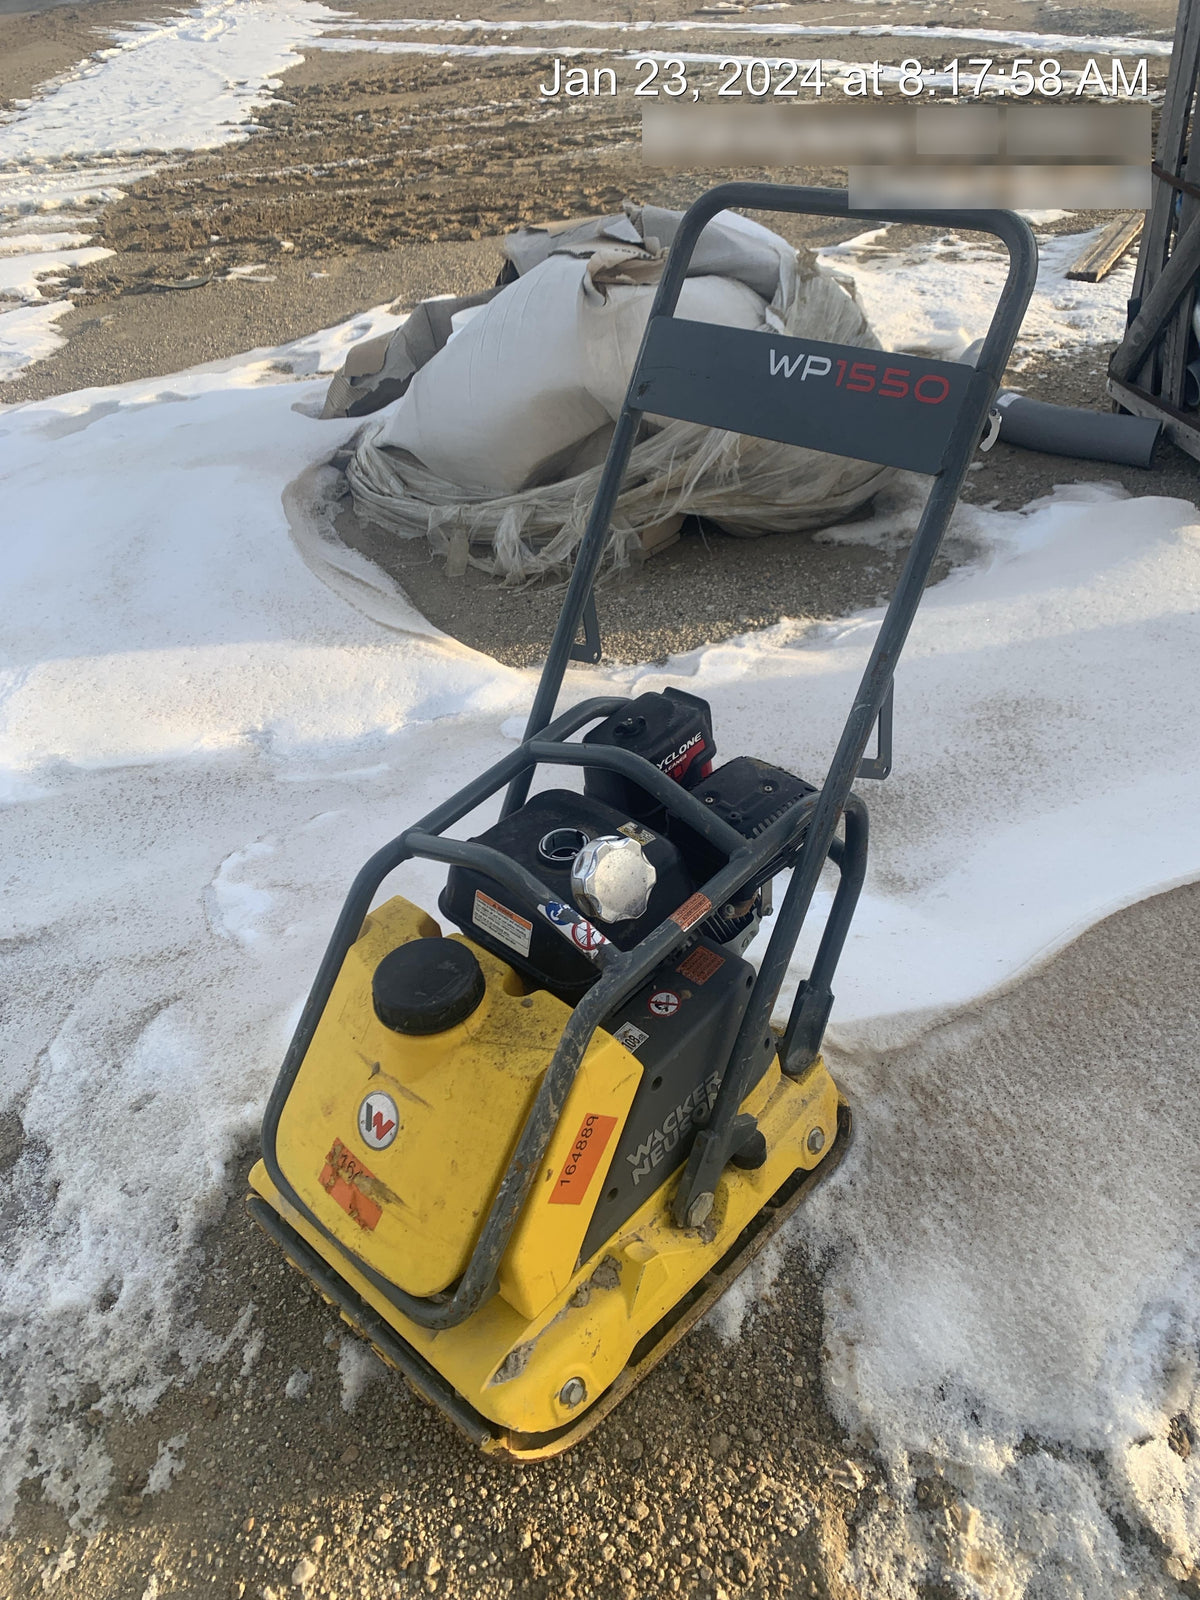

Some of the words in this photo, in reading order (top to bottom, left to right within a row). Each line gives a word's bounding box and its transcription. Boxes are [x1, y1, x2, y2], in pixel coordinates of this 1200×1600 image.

[769, 349, 950, 404] WP1550
[656, 731, 702, 770] YCLONE
[626, 1070, 720, 1166] WACKER
[560, 1114, 600, 1187] 164889
